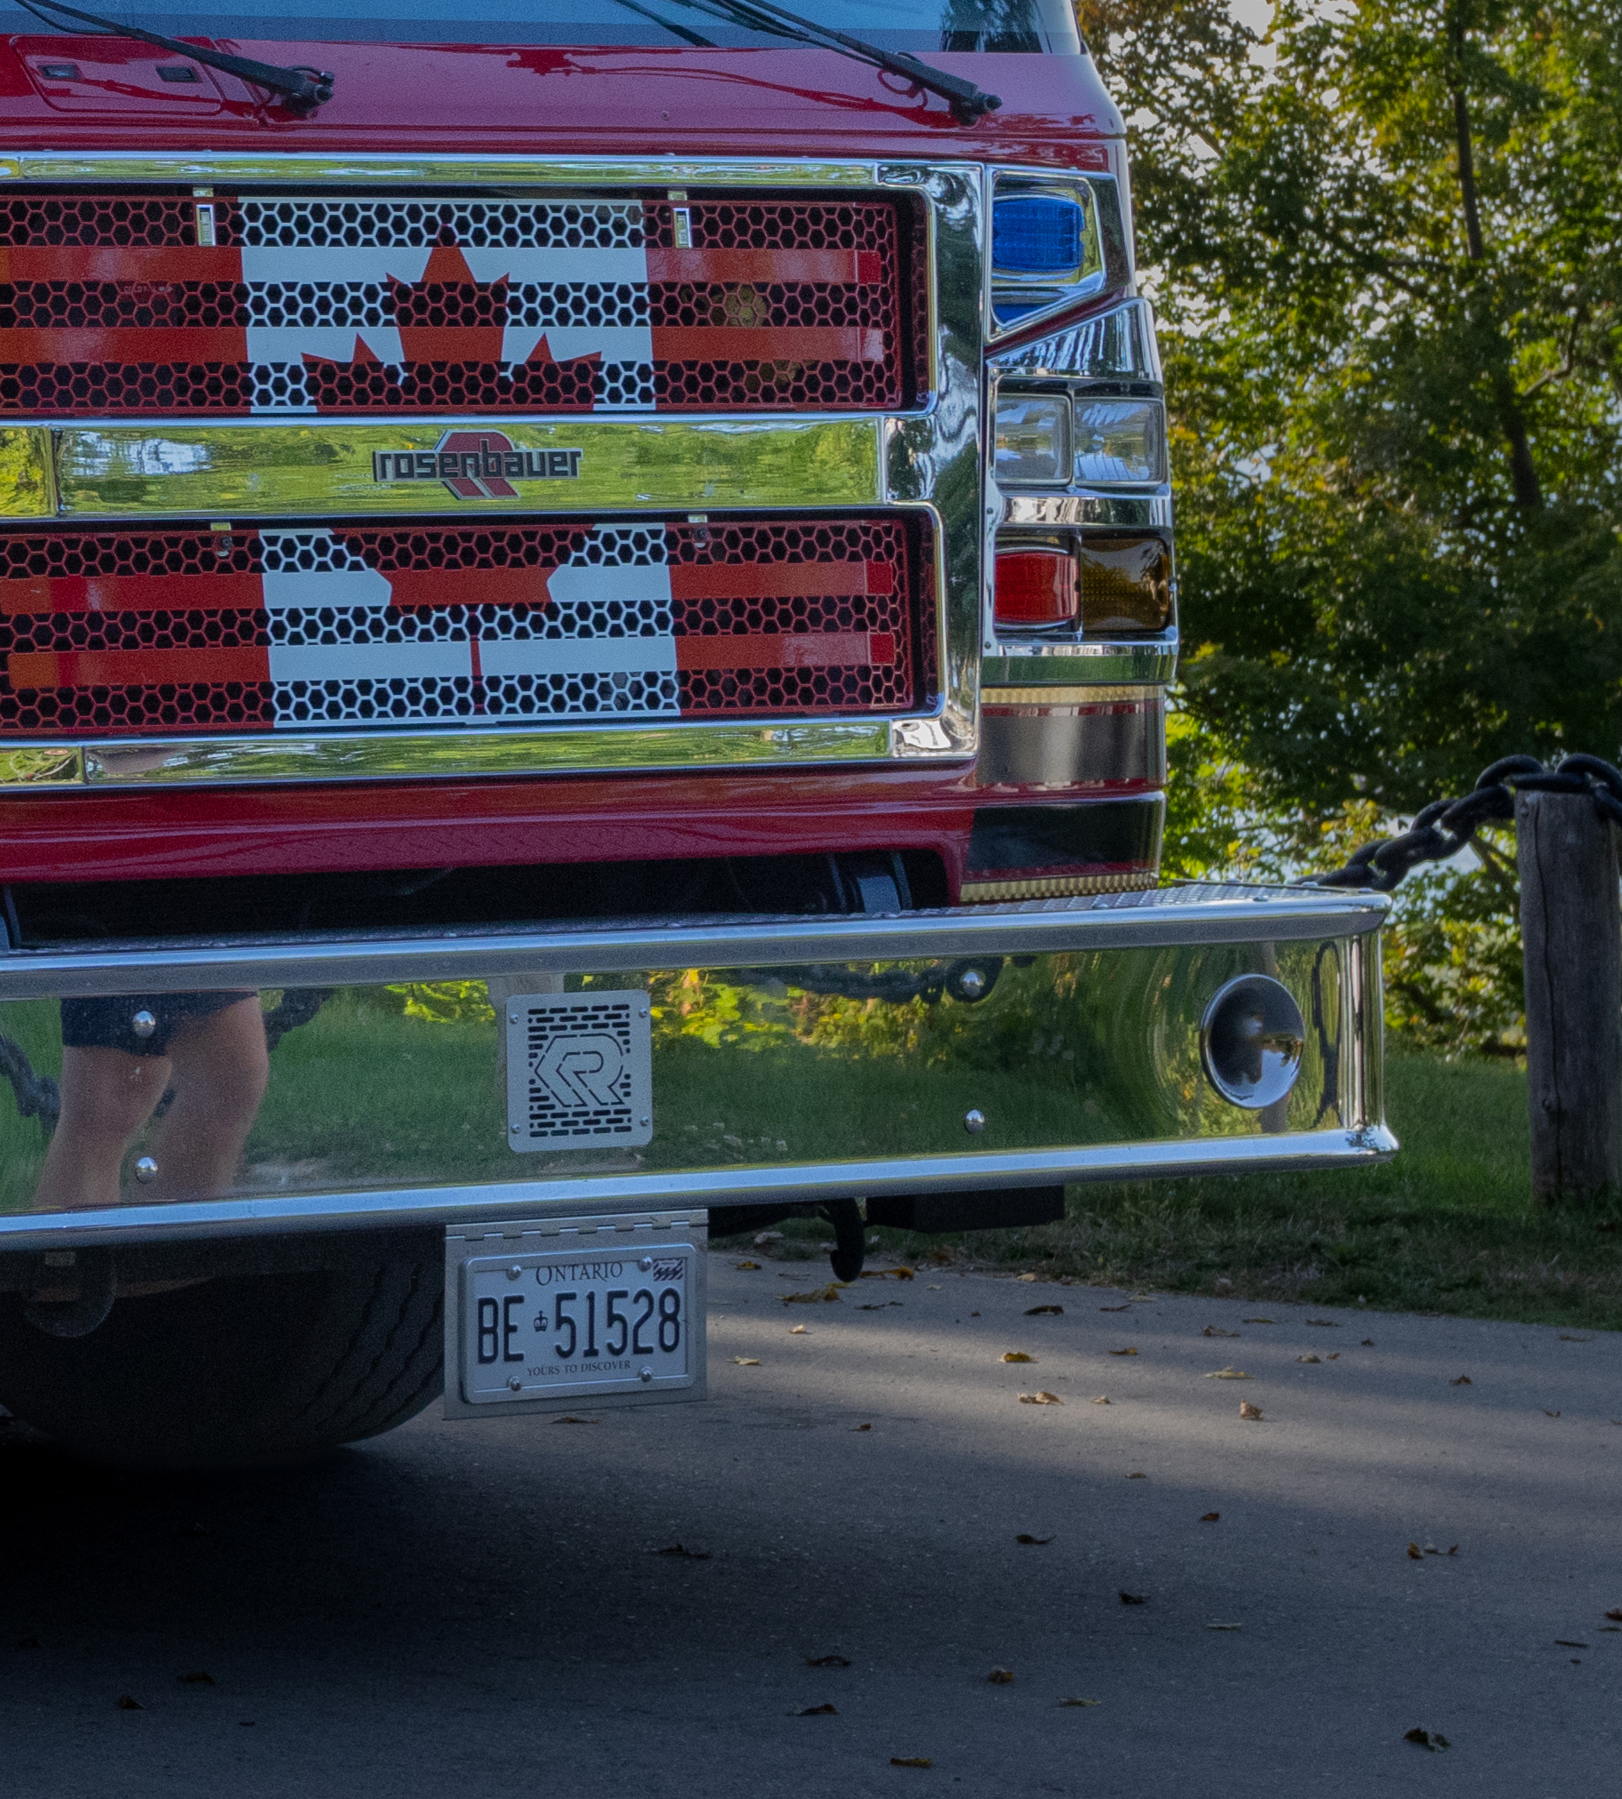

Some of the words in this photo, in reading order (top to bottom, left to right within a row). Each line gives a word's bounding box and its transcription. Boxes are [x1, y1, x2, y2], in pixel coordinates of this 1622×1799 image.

[374, 438, 583, 482] rosenbauer
[535, 1262, 624, 1286] ONTARIO
[527, 1365, 560, 1377] YOURS
[564, 1364, 577, 1374] TO
[581, 1360, 631, 1373] DISCOVER
